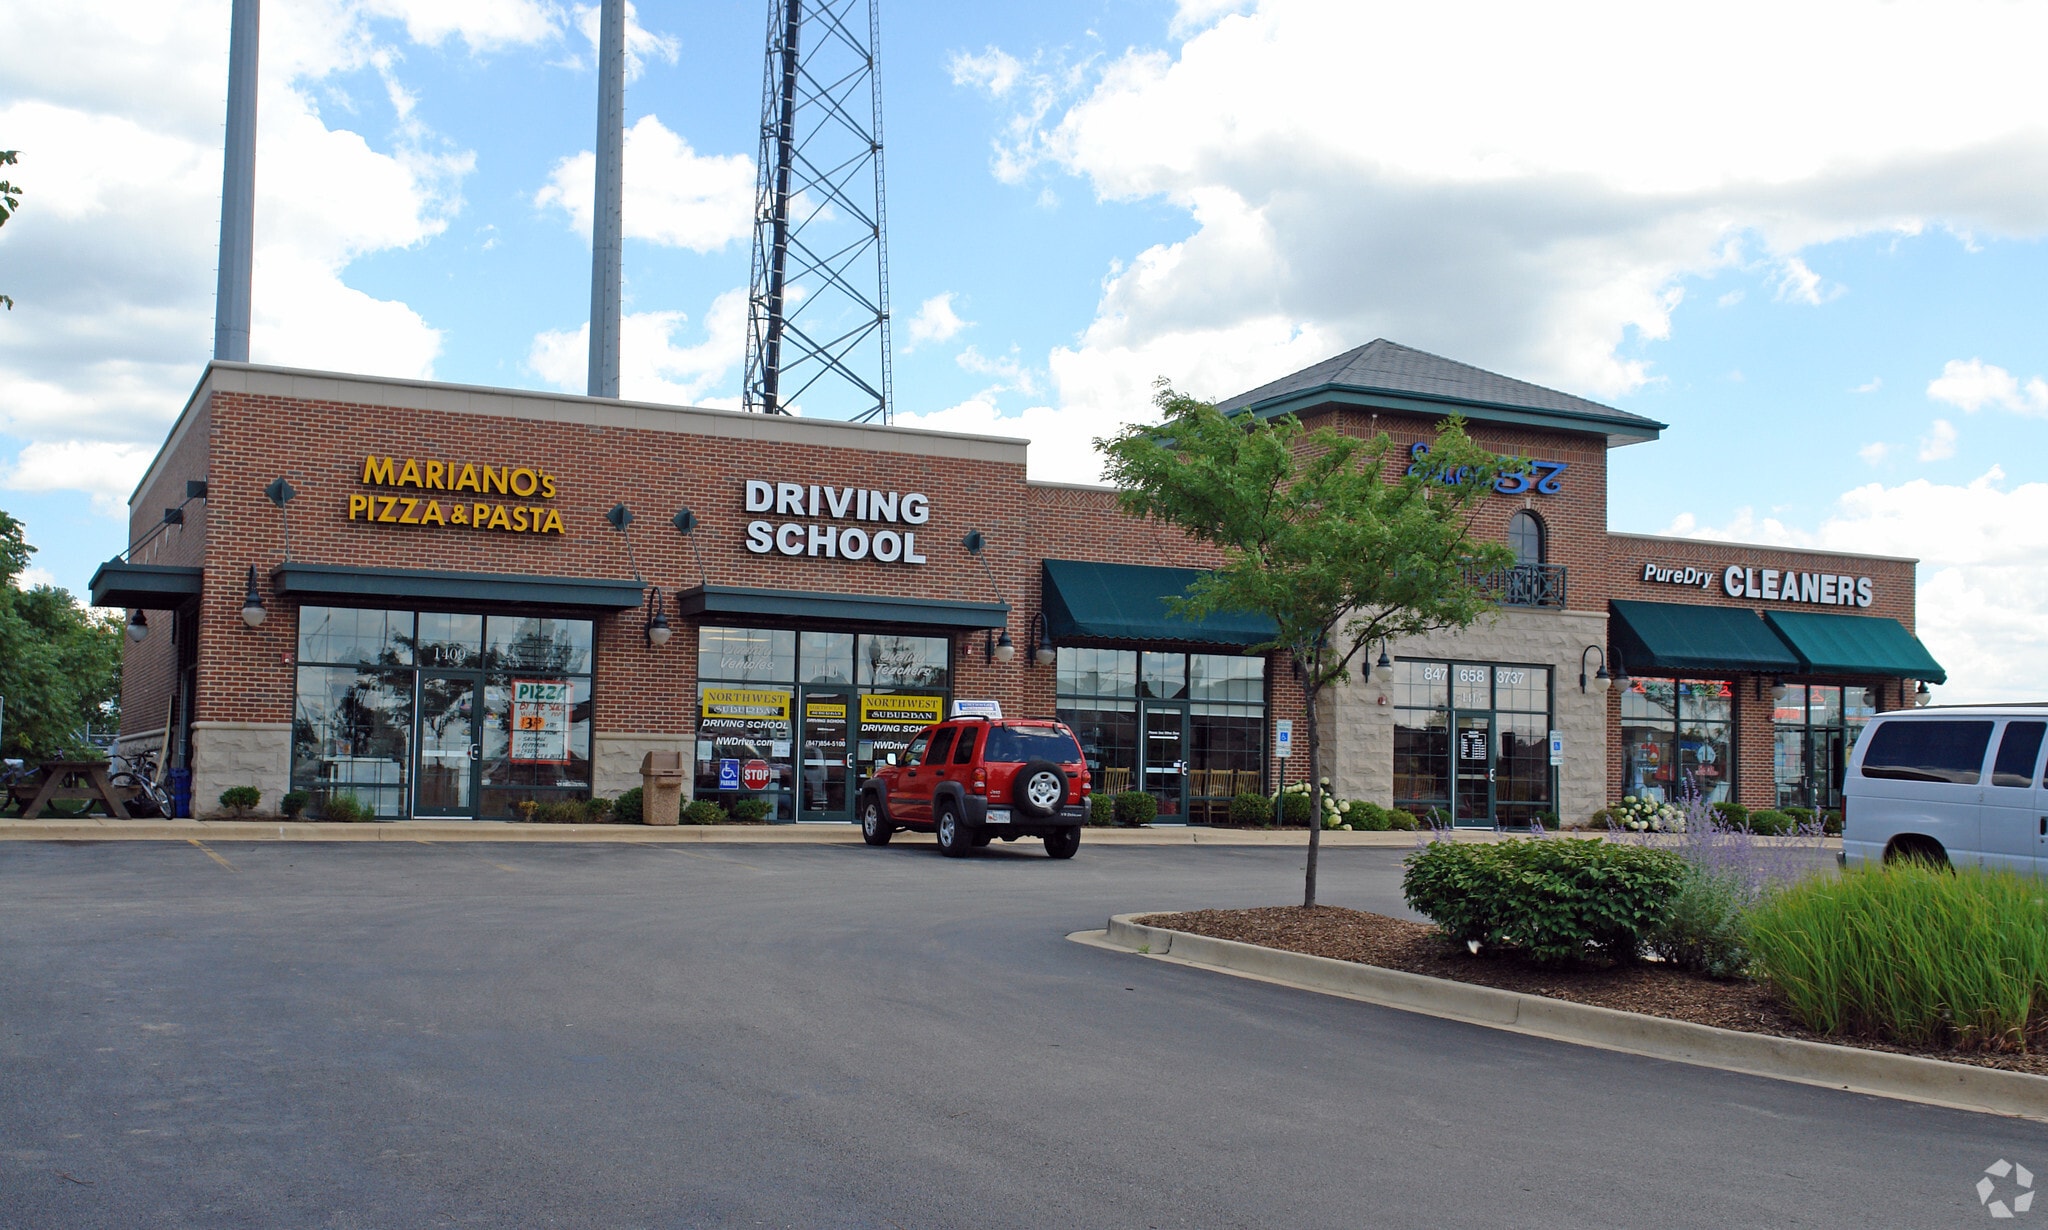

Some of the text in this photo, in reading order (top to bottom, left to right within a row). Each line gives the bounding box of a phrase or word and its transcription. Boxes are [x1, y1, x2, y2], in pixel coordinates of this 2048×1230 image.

[746, 480, 930, 525] DRIVING
[349, 494, 565, 534] PIZZA & PASTA
[745, 520, 927, 564] SCHOOL
[1644, 563, 1873, 607] PureDry CLEANERS
[434, 647, 467, 661] 1409
[721, 657, 775, 670] Vehicles
[875, 663, 932, 677] Teachers
[1424, 667, 1524, 684] 847 658 3737
[708, 692, 785, 704] NORTHWEST
[867, 698, 938, 708] NORTHWEST
[713, 705, 779, 715] SUBURBAN
[871, 711, 932, 719] SUBURBAN
[702, 719, 789, 729] DRIVING SCHOOL
[861, 724, 928, 733] DRIVING SCH
[716, 737, 775, 747] NWDrive.com
[744, 769, 769, 781] STOP
